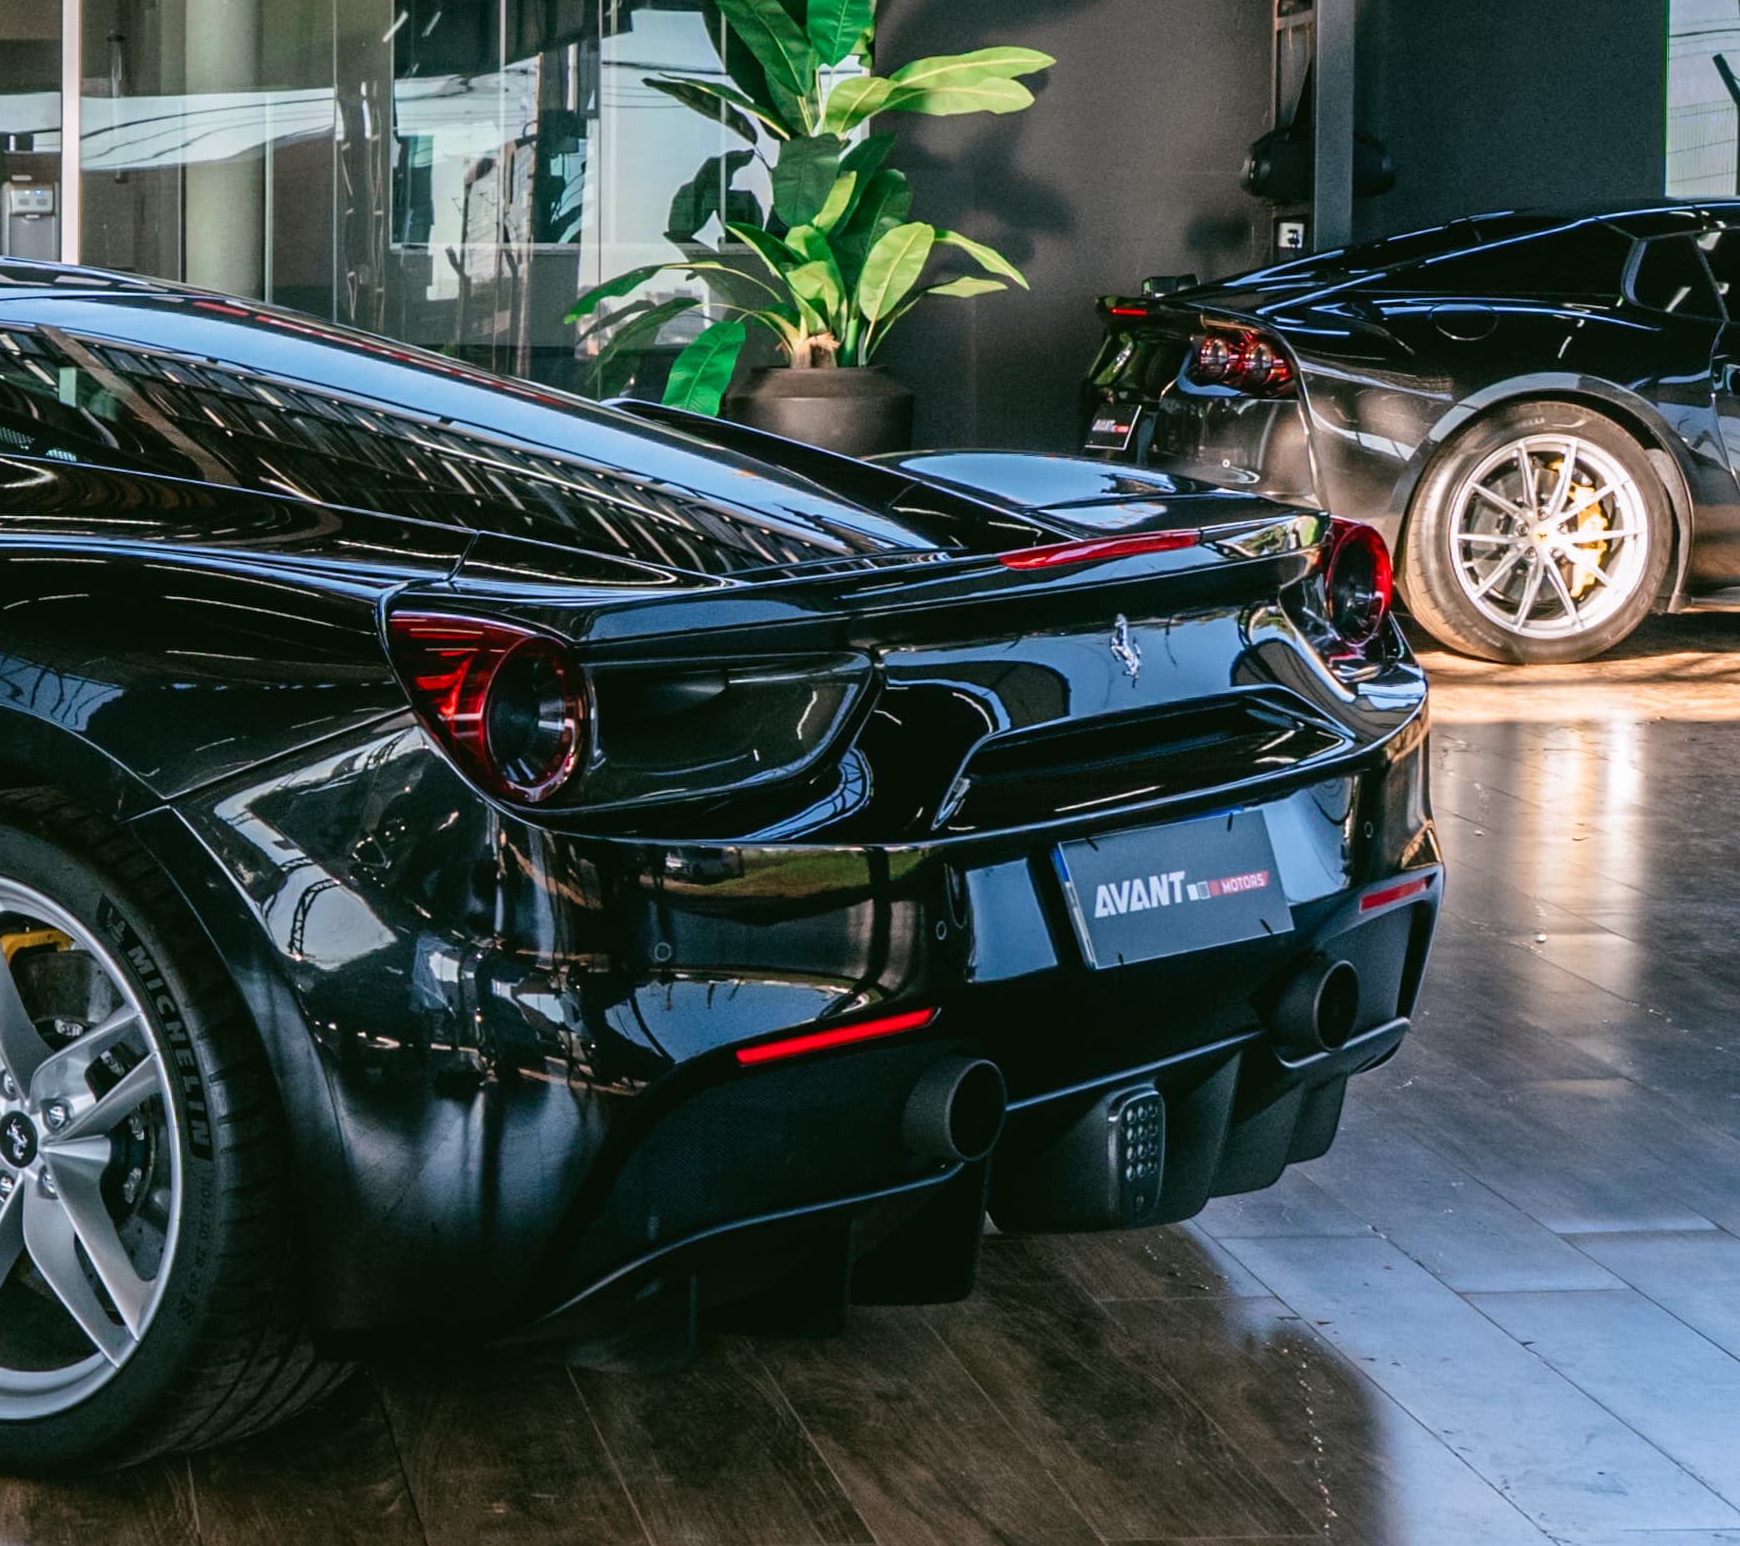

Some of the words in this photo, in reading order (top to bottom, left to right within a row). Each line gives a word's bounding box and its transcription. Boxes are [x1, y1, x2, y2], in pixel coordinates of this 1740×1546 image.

[1094, 870, 1186, 918] AVANT
[1221, 874, 1265, 893] MOTORS
[127, 945, 211, 1150] MICHELIN
